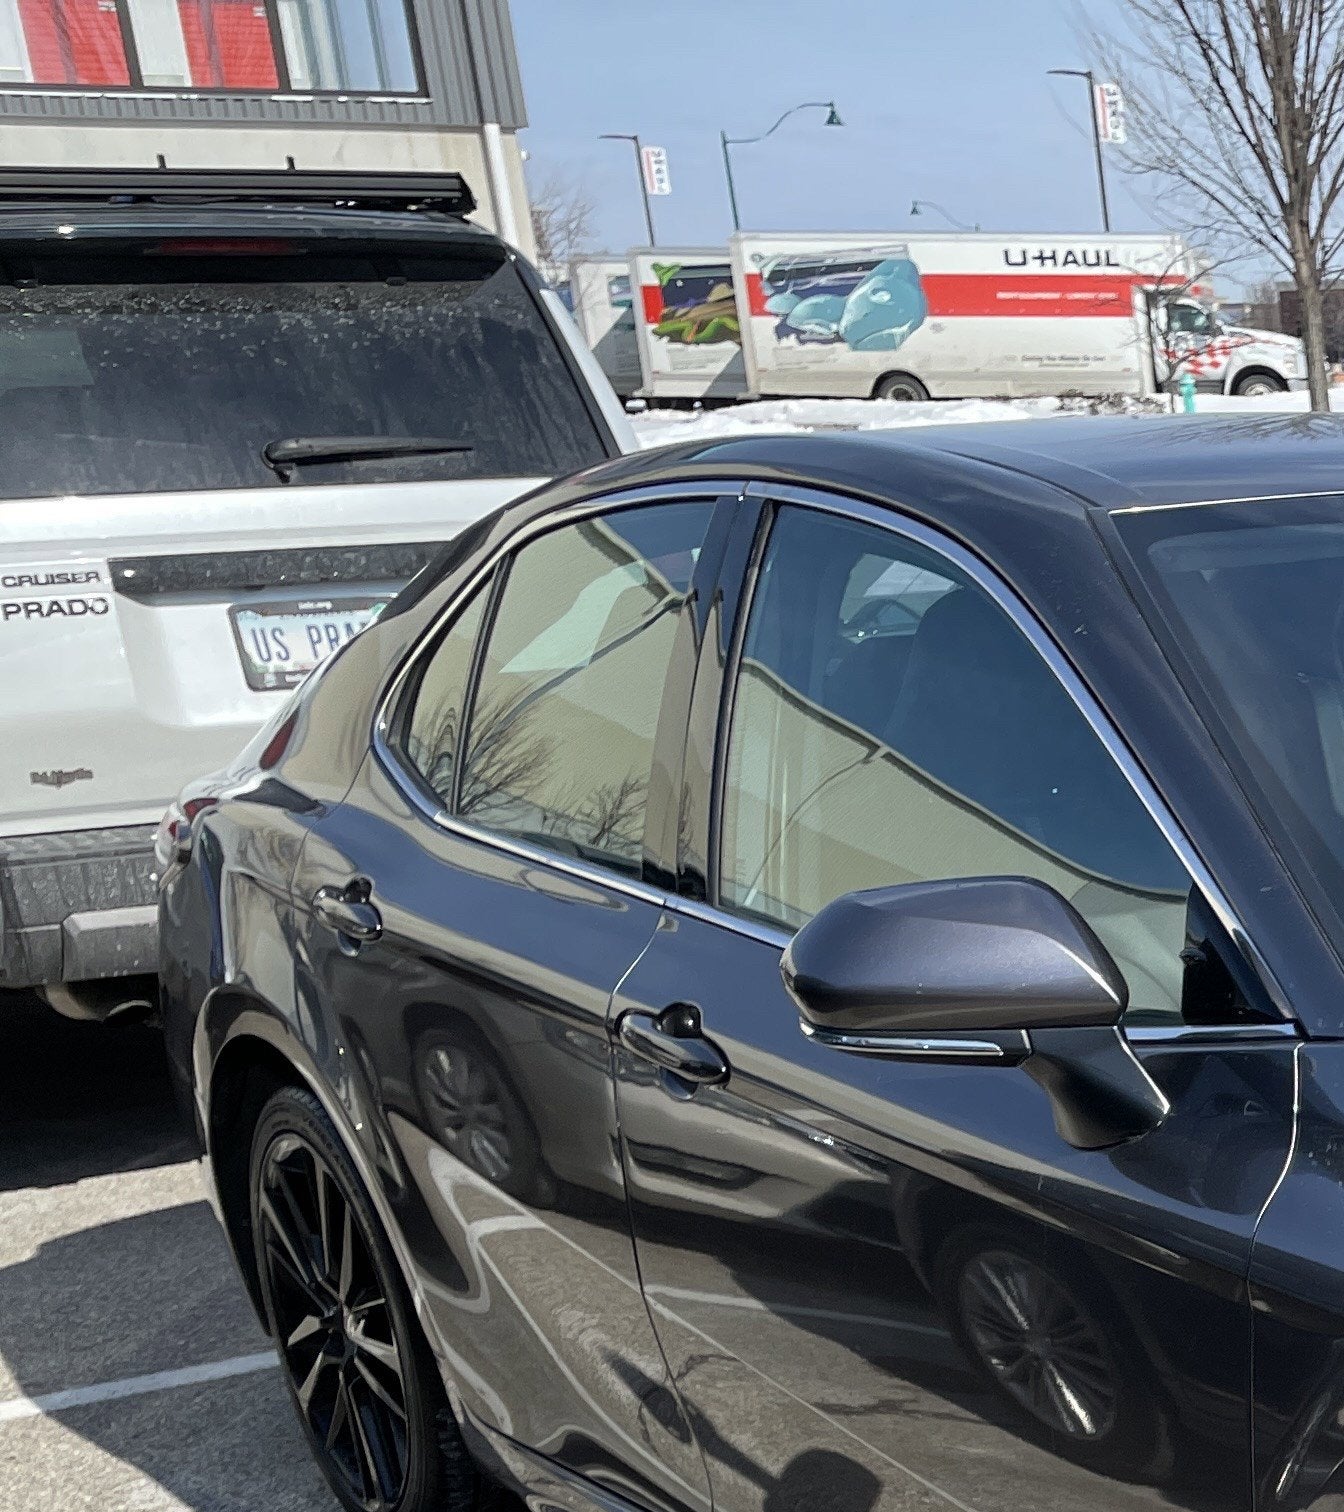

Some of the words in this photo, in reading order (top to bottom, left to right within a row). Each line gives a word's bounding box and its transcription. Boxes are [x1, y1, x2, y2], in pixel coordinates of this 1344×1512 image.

[2, 571, 101, 587] CRUISER
[2, 597, 109, 620] PRADO
[251, 627, 290, 662] US
